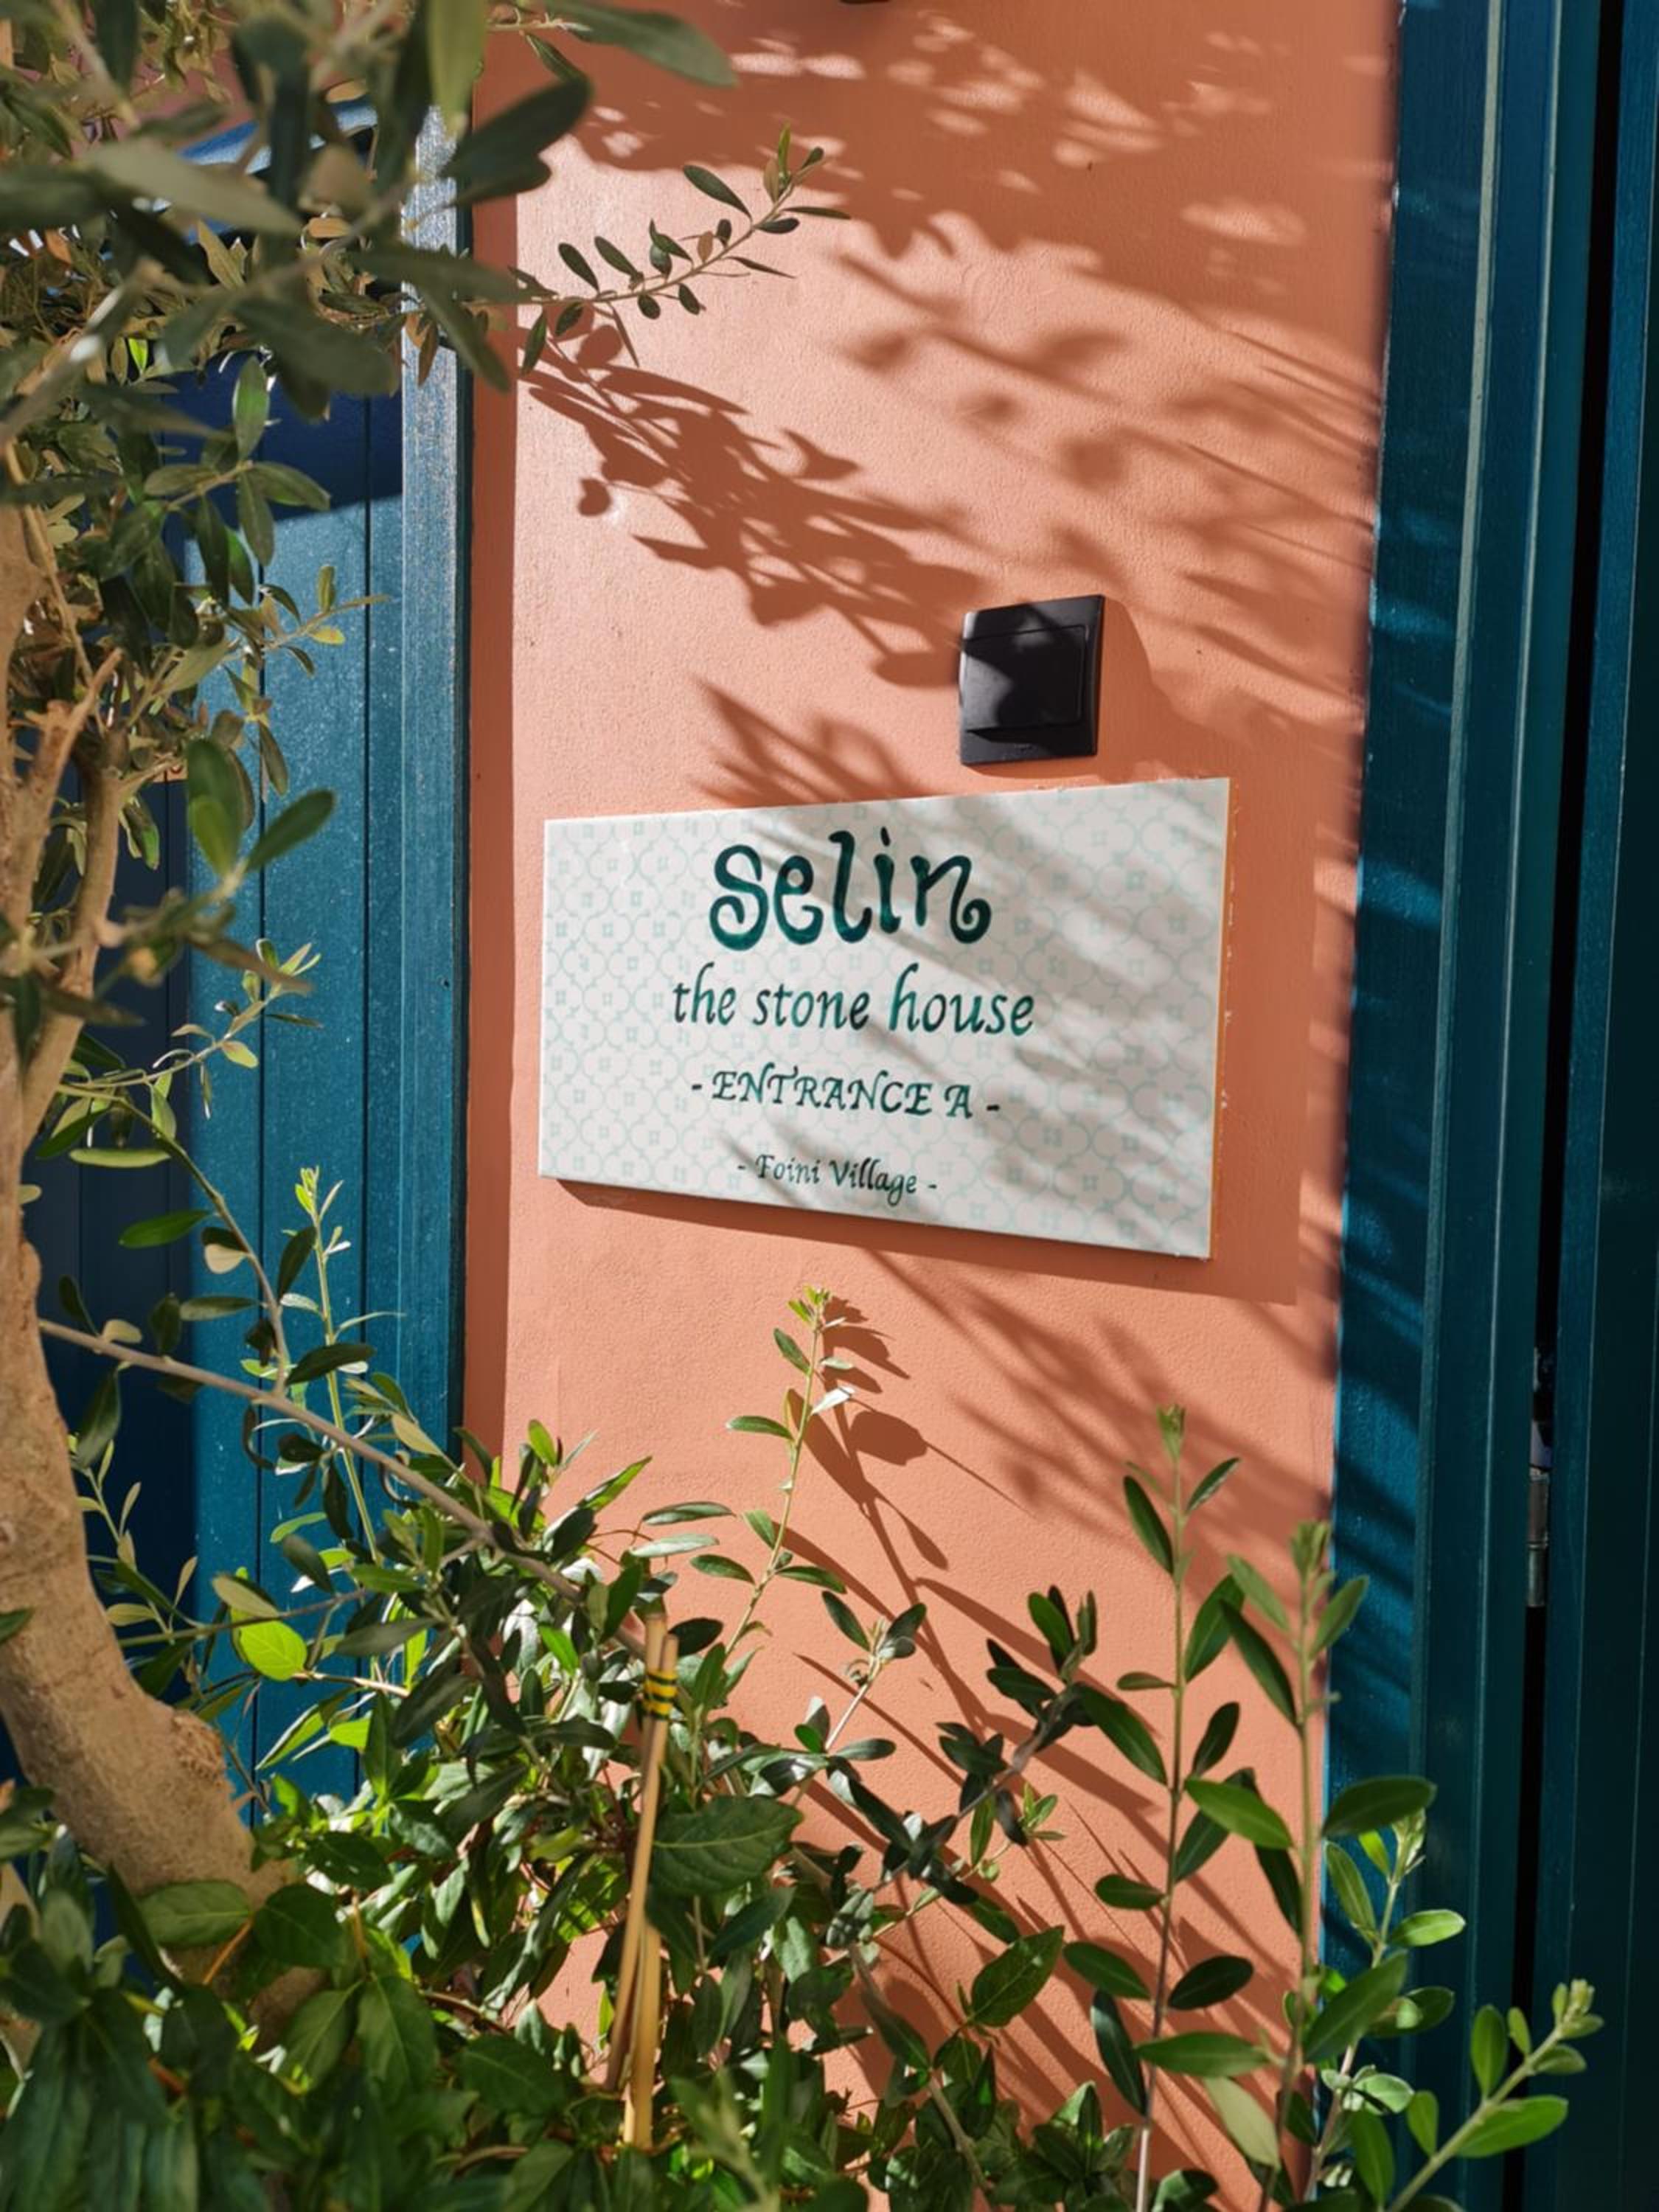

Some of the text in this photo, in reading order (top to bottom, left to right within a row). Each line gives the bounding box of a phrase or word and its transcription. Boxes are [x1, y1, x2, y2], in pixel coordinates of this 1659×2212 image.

[709, 825, 993, 952] Selin
[672, 961, 1034, 1037] the stone house
[943, 1084, 974, 1120] A
[755, 1153, 822, 1185] Foini
[827, 1156, 918, 1207] Village
